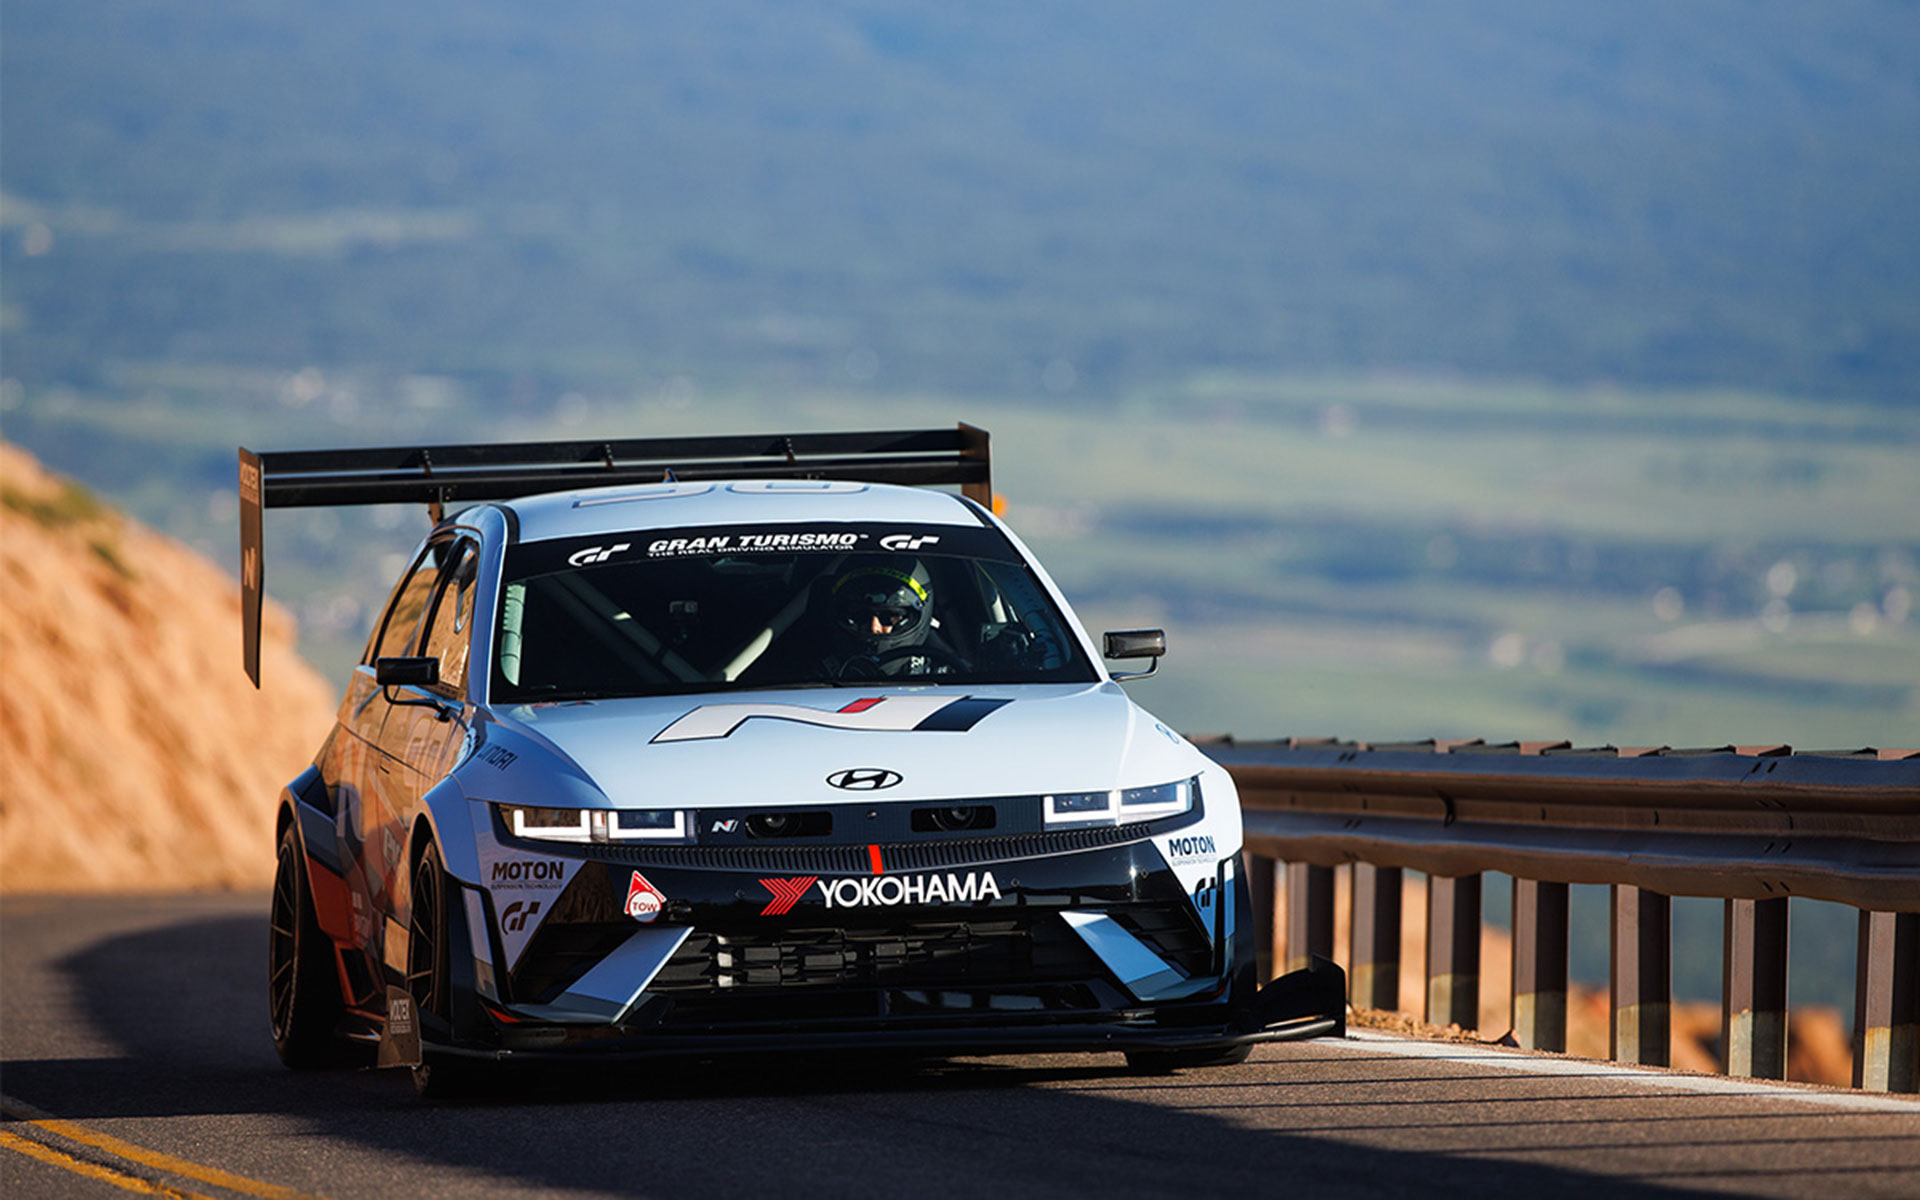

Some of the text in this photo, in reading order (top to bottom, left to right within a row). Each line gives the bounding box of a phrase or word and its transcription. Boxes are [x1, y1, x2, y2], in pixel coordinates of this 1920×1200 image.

[648, 533, 858, 552] GRAN TURISMO
[1168, 834, 1216, 857] MOTON
[492, 861, 564, 880] MOTON
[817, 871, 1002, 908] YOKOHAMA
[632, 901, 658, 912] TOW
